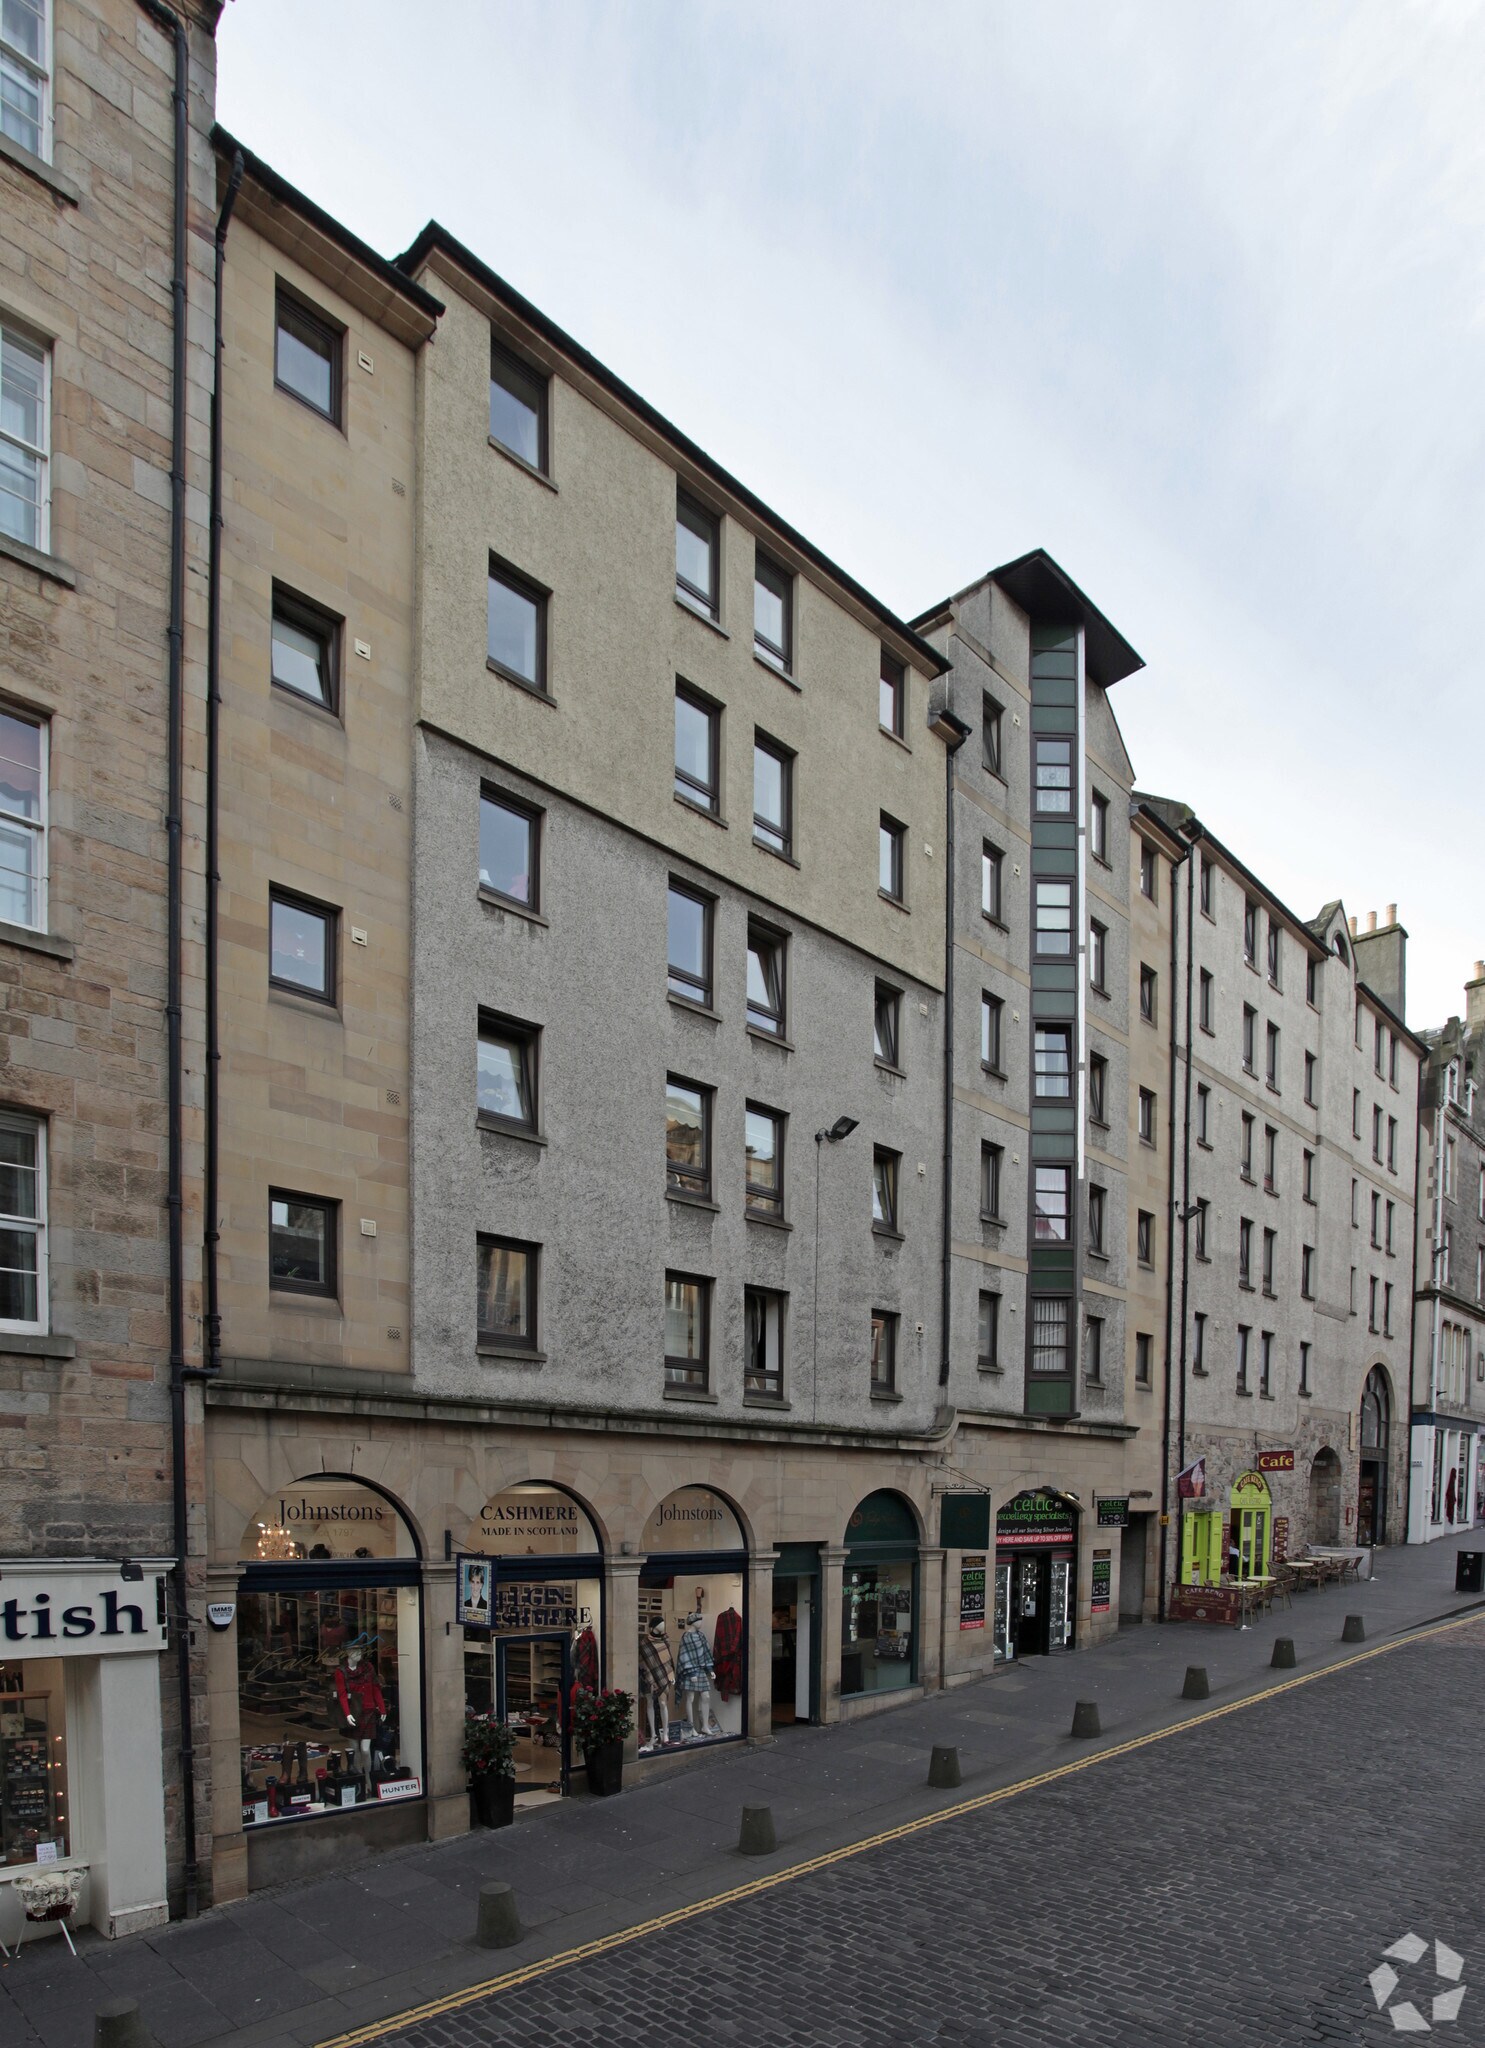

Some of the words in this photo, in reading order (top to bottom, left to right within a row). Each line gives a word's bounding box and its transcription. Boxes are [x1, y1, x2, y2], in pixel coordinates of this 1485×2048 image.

[1260, 1455, 1293, 1468] Cafe
[275, 1499, 383, 1527] Johnstons
[480, 1505, 577, 1520] CASHMERE
[656, 1503, 723, 1526] Johnstons
[997, 1512, 1033, 1522] ewellery
[1034, 1511, 1069, 1521] specialists
[481, 1527, 511, 1536] MADE
[514, 1527, 524, 1535] IN
[527, 1527, 578, 1536] SCOTLAND
[0, 1590, 148, 1640] tish
[499, 1605, 591, 1628] SHMERE
[381, 1784, 417, 1794] HUNTER
